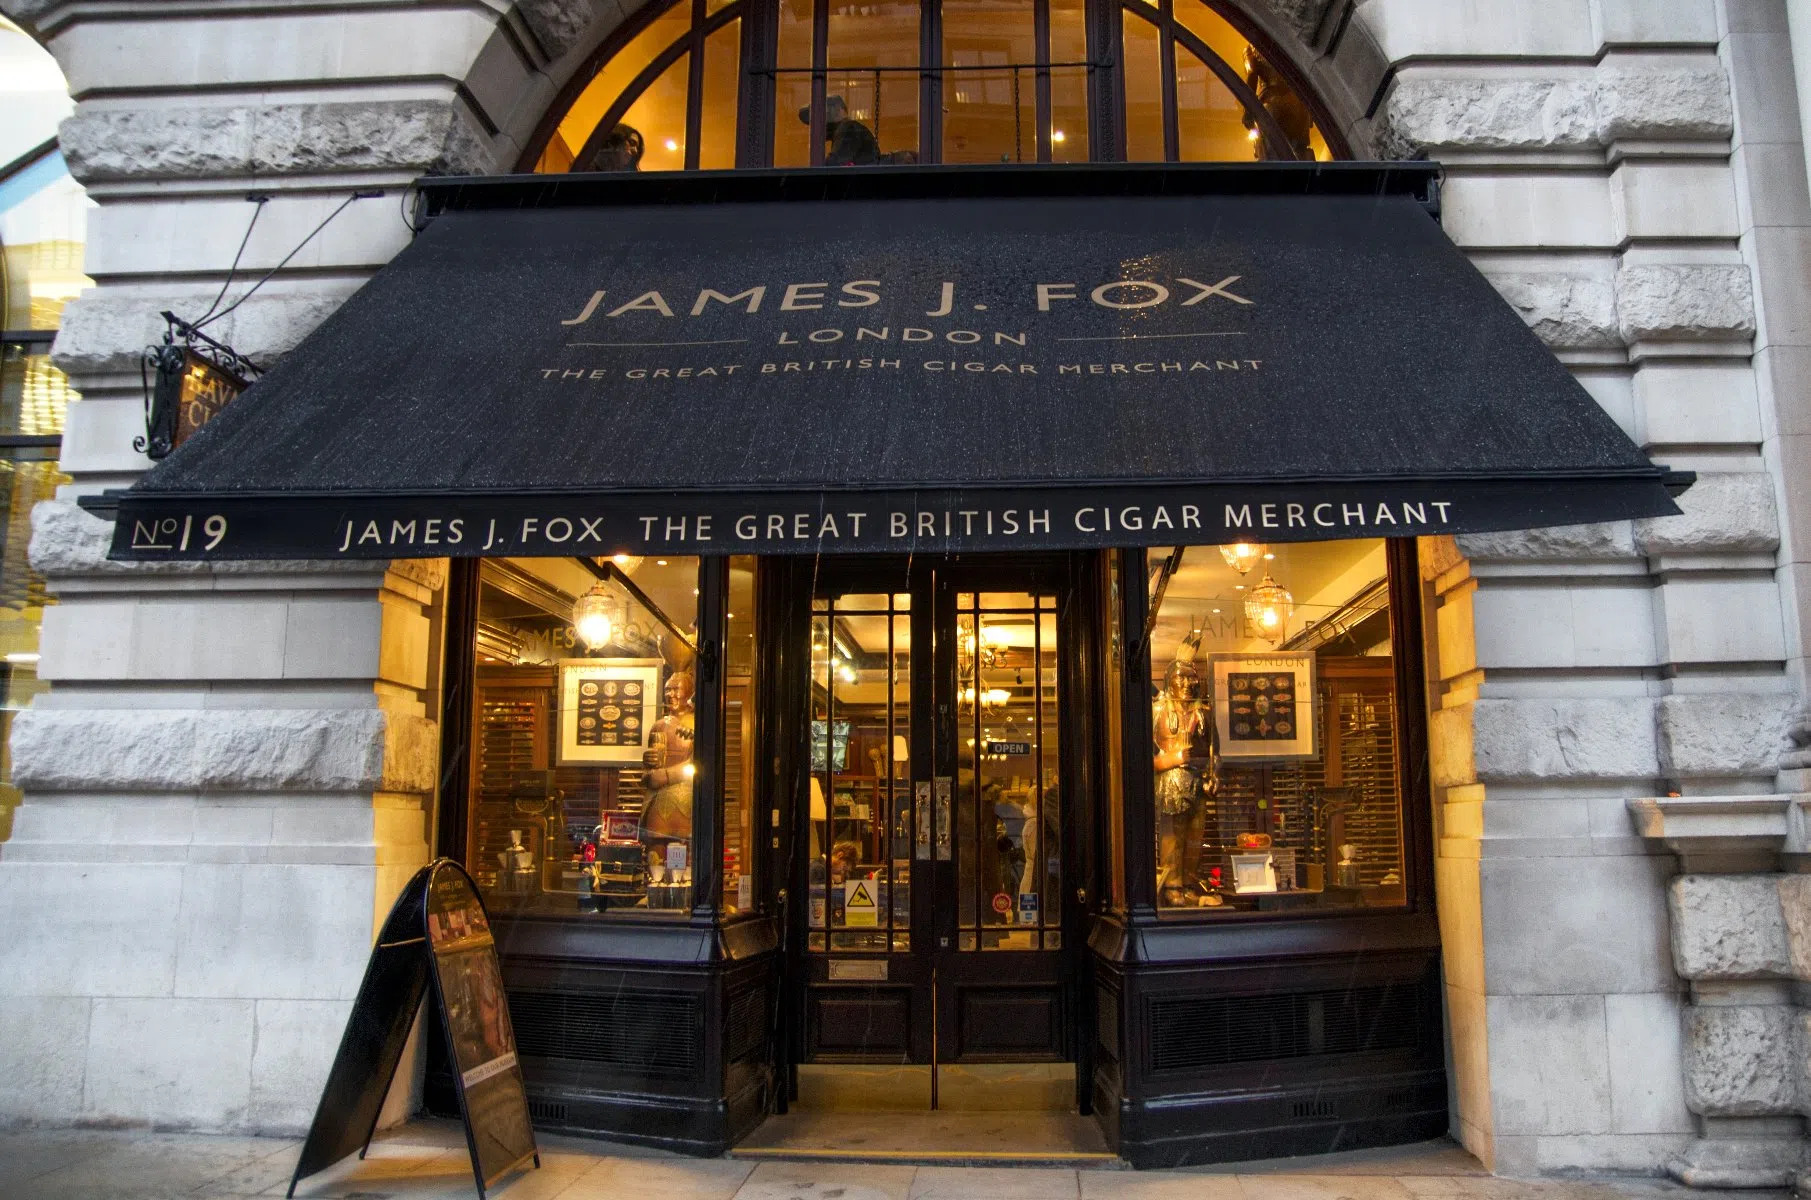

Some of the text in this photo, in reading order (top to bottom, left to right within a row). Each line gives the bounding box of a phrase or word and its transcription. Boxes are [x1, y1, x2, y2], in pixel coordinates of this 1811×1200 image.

[561, 275, 1256, 326] JAMES J. FOX
[778, 327, 1026, 346] LONDON
[541, 358, 1263, 379] THE GREAT BRITISH CIGAR MERCHANT
[339, 501, 1451, 552] JAMES J. FOX THE GREAT BRITISH CIGAR MERCHANT
[1305, 620, 1356, 645] FOX
[1246, 657, 1305, 669] LONDON
[994, 743, 1025, 754] OPEN
